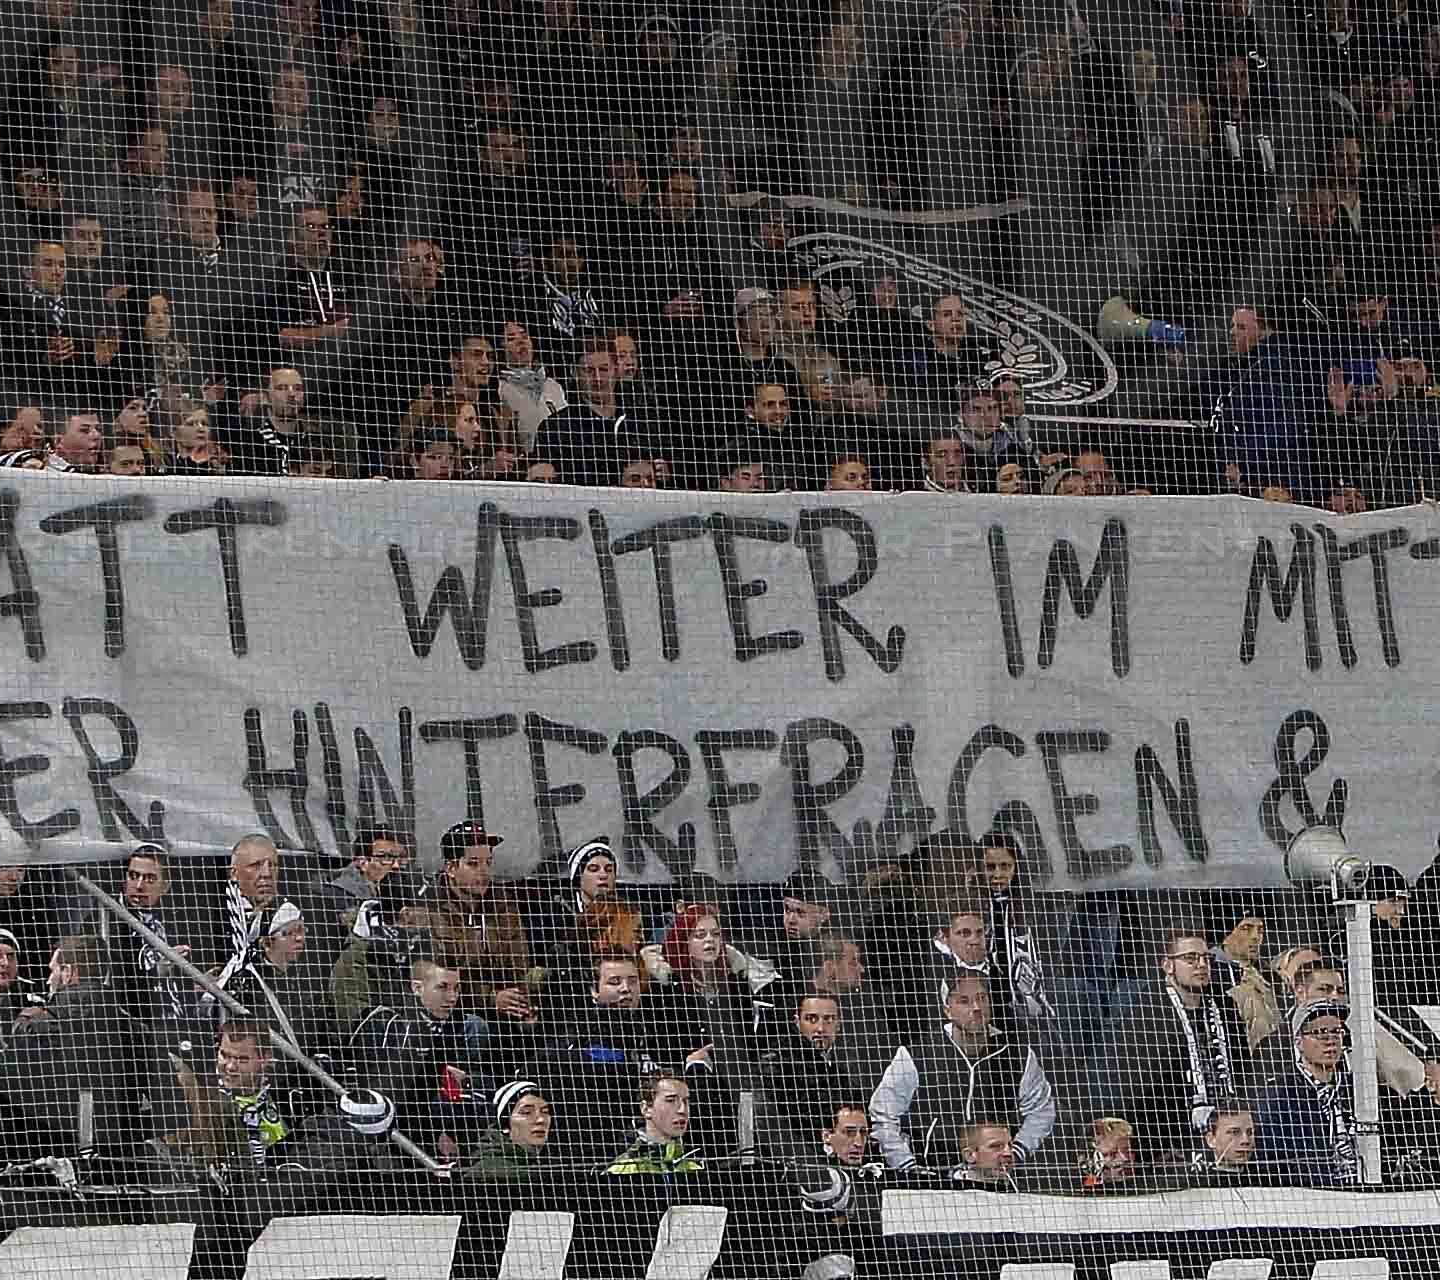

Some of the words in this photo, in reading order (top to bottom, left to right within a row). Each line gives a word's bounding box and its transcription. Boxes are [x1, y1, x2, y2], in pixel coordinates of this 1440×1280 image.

[390, 501, 906, 681] WEITER
[987, 517, 1132, 679] IM
[243, 700, 1210, 883] HINTERFRAGEN
[1259, 707, 1350, 856] &
